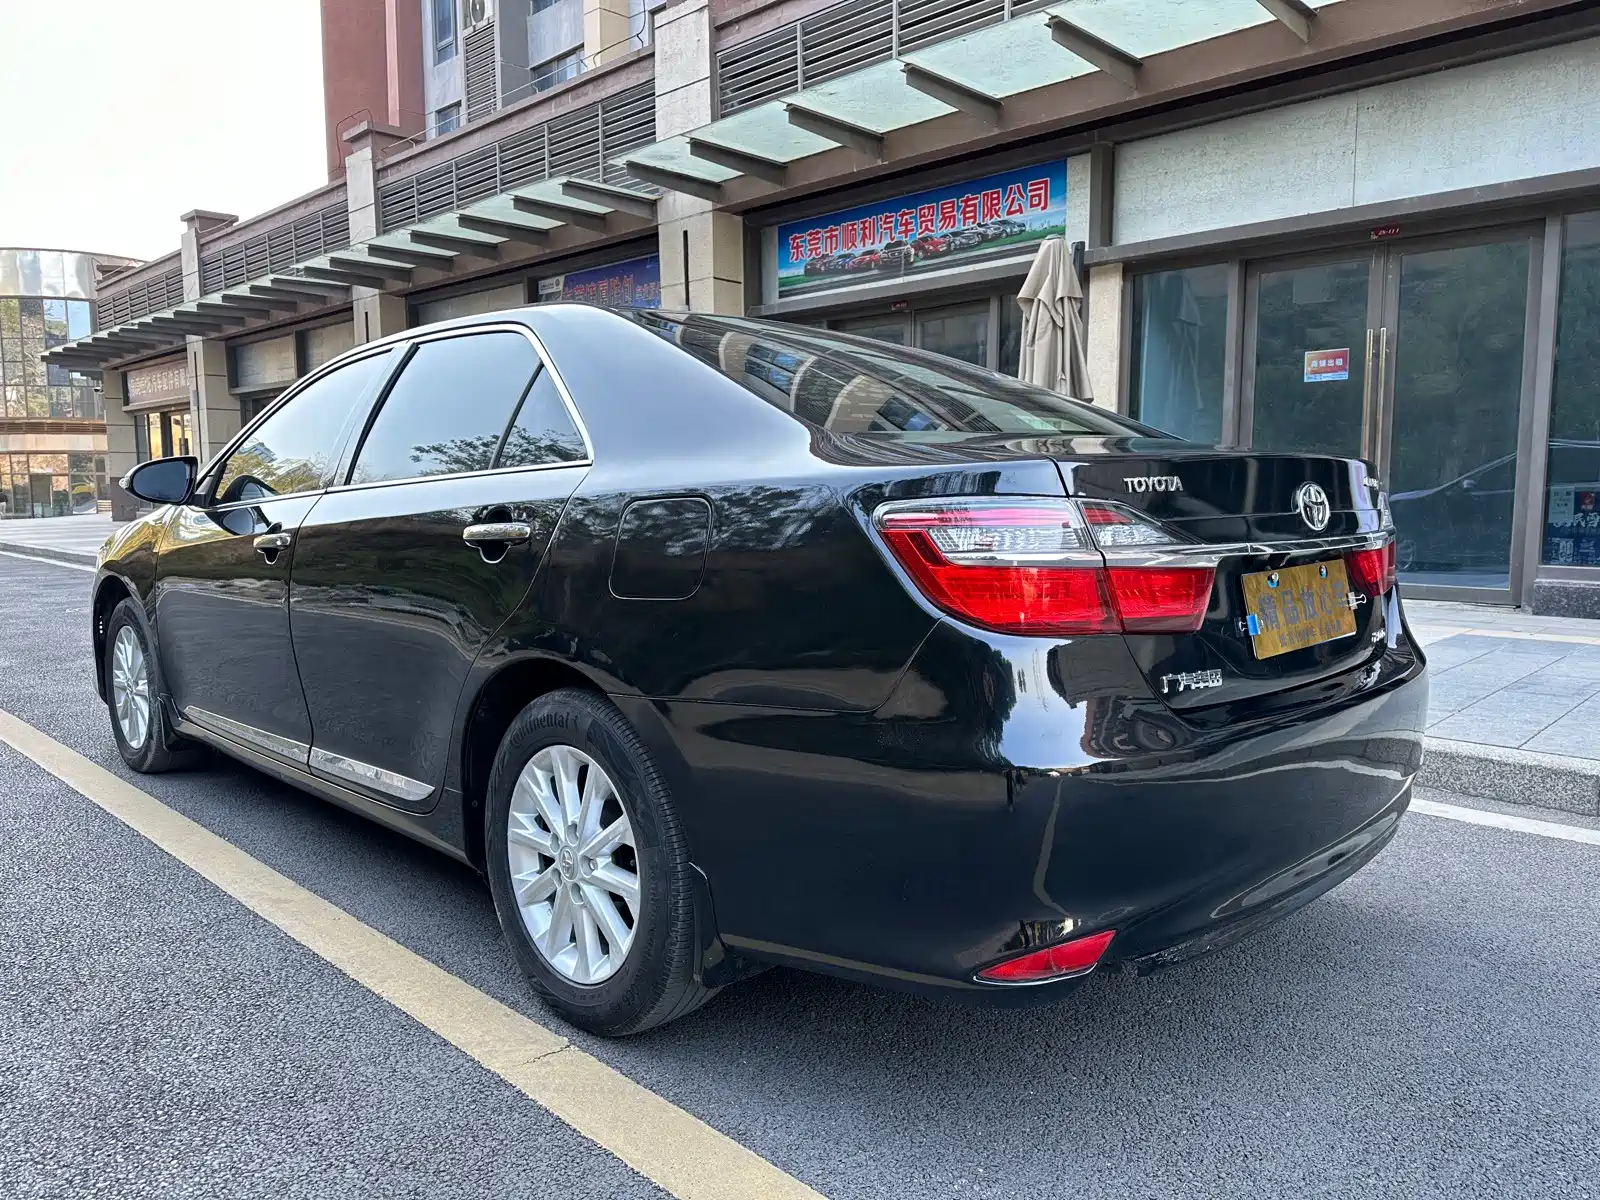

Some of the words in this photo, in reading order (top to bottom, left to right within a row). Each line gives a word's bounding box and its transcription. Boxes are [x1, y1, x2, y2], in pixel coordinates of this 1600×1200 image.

[789, 177, 1050, 263] 东莞市顺利汽车贸易有限公司
[1123, 475, 1183, 493] TOYOTA
